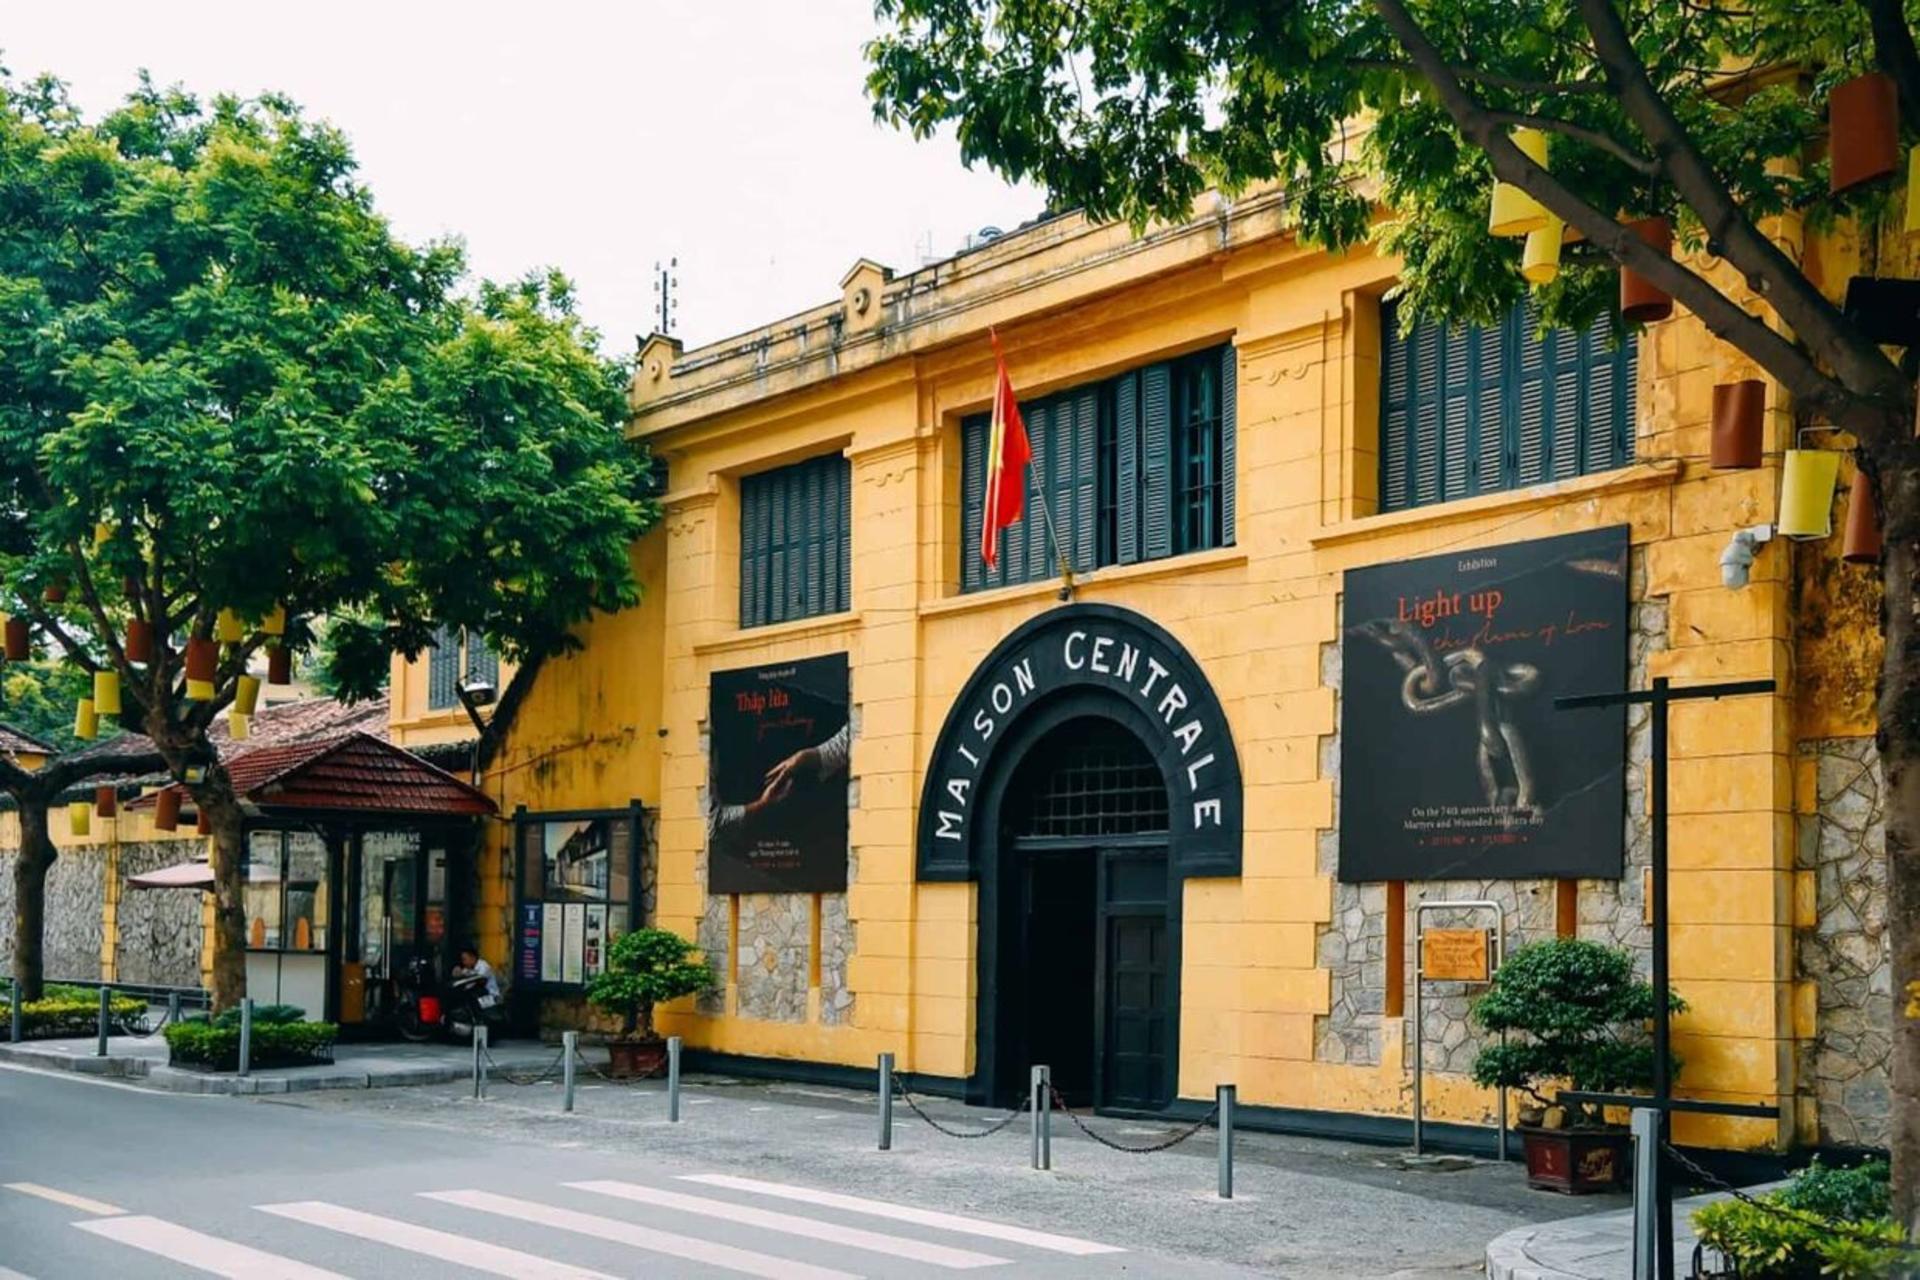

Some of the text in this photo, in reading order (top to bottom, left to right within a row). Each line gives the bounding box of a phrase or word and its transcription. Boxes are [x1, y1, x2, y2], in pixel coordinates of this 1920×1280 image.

[1458, 558, 1497, 572] Exhibition
[1398, 588, 1502, 628] Light up
[935, 630, 1221, 841] MAISON CENTRALE
[1412, 807, 1425, 817] On
[1427, 806, 1440, 817] the
[1403, 820, 1435, 831] Martyrs
[1436, 819, 1451, 829] and
[1453, 816, 1493, 828] Wounded
